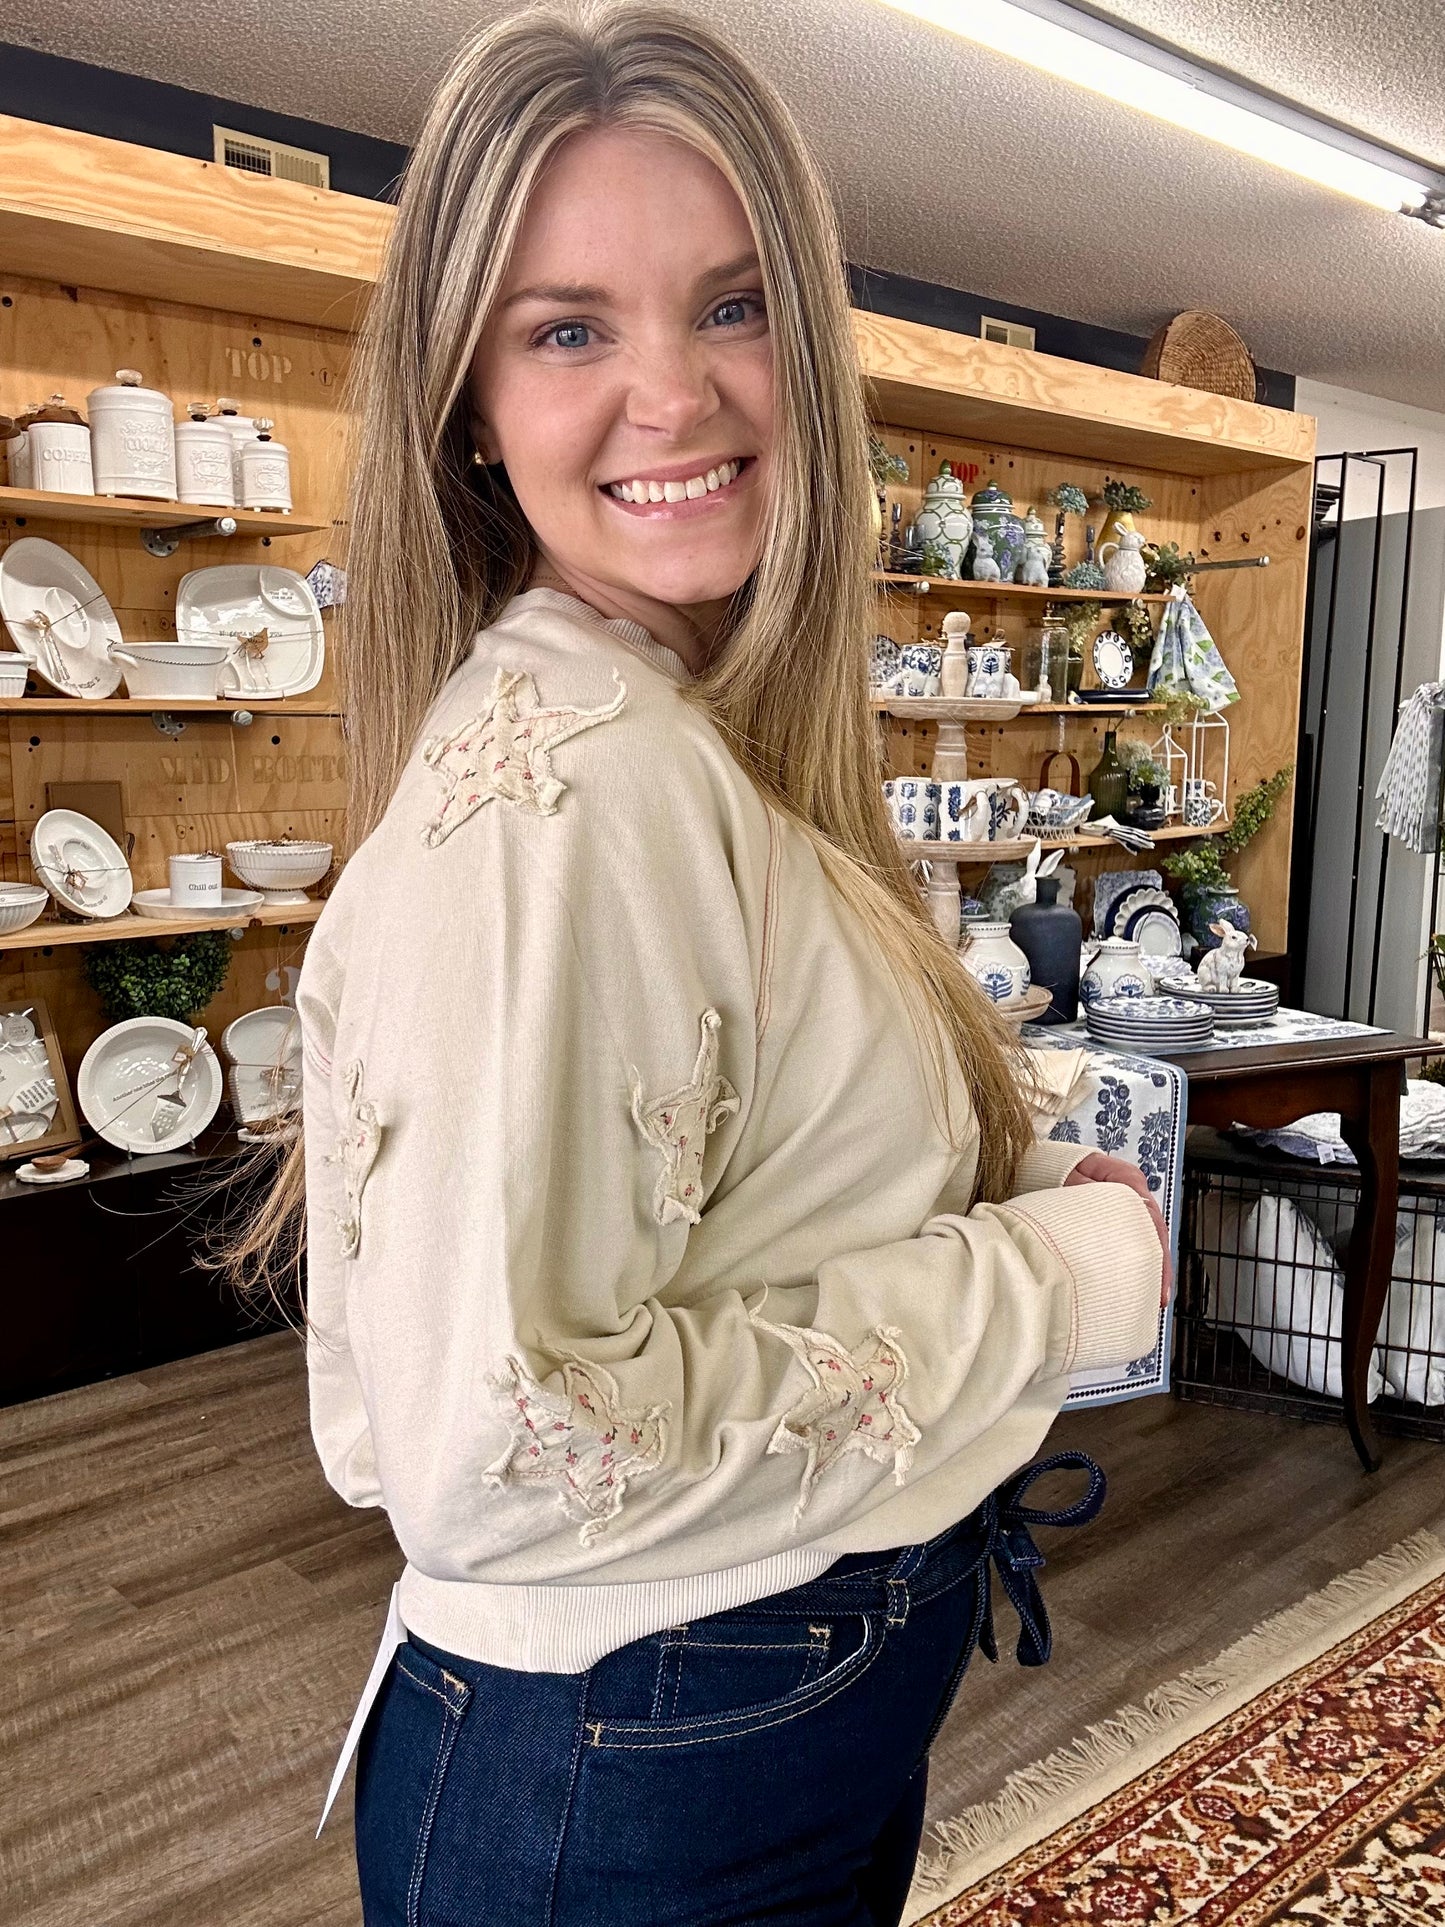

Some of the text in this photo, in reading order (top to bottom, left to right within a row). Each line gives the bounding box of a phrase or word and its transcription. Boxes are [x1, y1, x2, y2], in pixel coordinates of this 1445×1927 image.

[225, 347, 292, 384] TOP
[160, 754, 230, 785] MID
[188, 883, 207, 891] Chill
